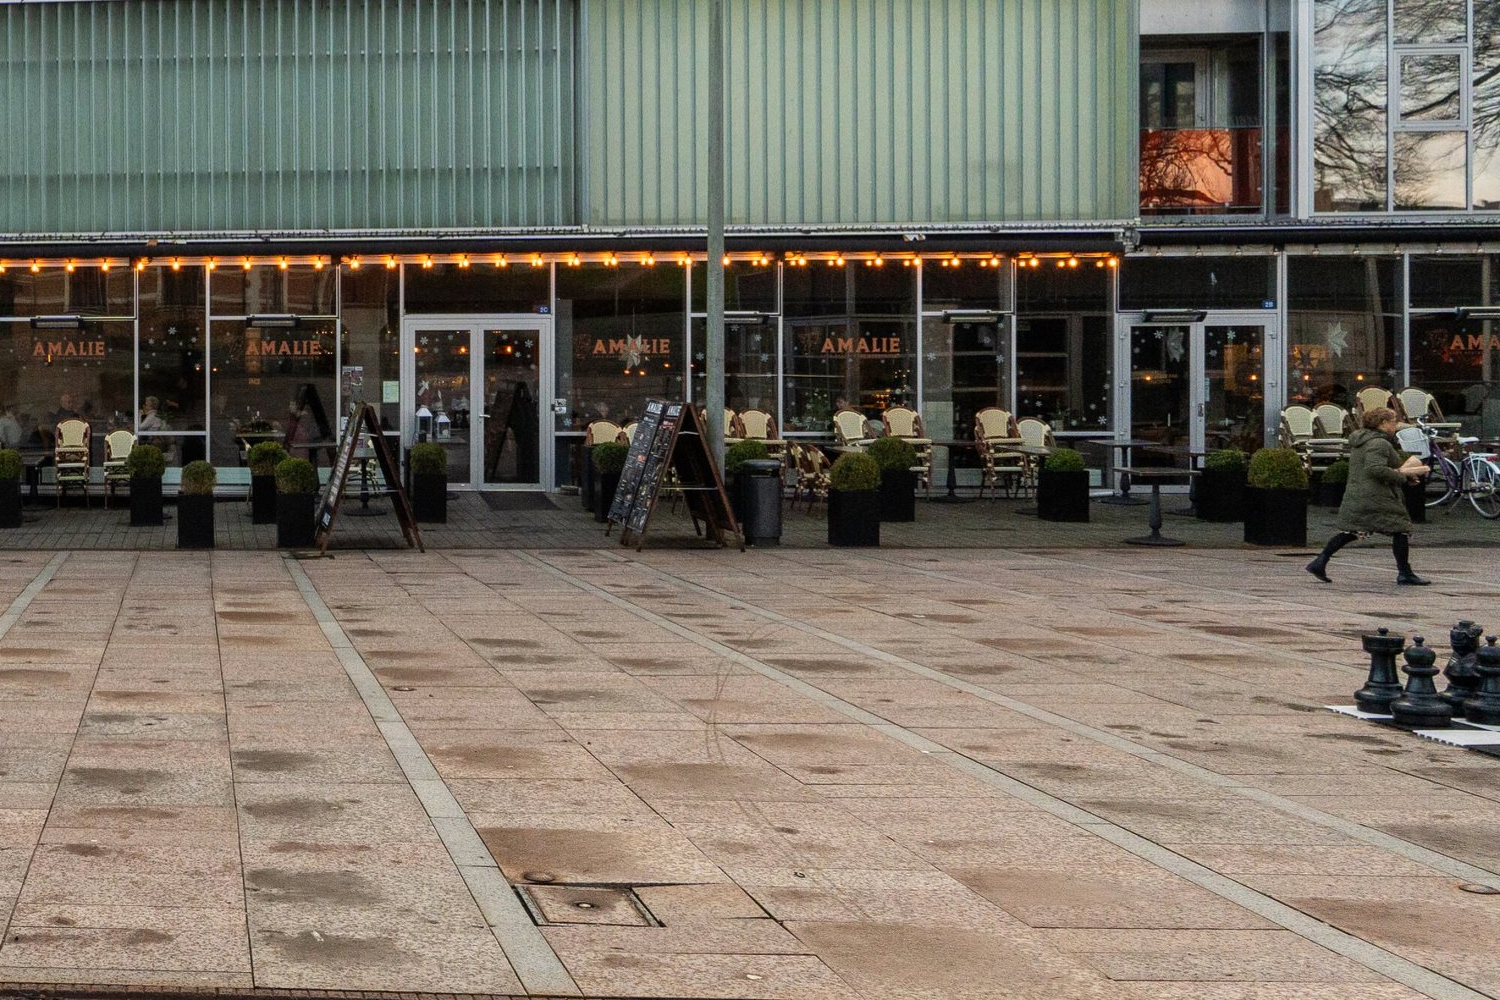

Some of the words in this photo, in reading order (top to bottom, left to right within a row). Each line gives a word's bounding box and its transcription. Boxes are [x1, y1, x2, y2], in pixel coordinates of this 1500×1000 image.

[32, 340, 105, 356] AMALIE
[245, 340, 321, 356] AMALIE
[592, 338, 670, 354] AMALIE
[821, 337, 901, 353] AMALIE
